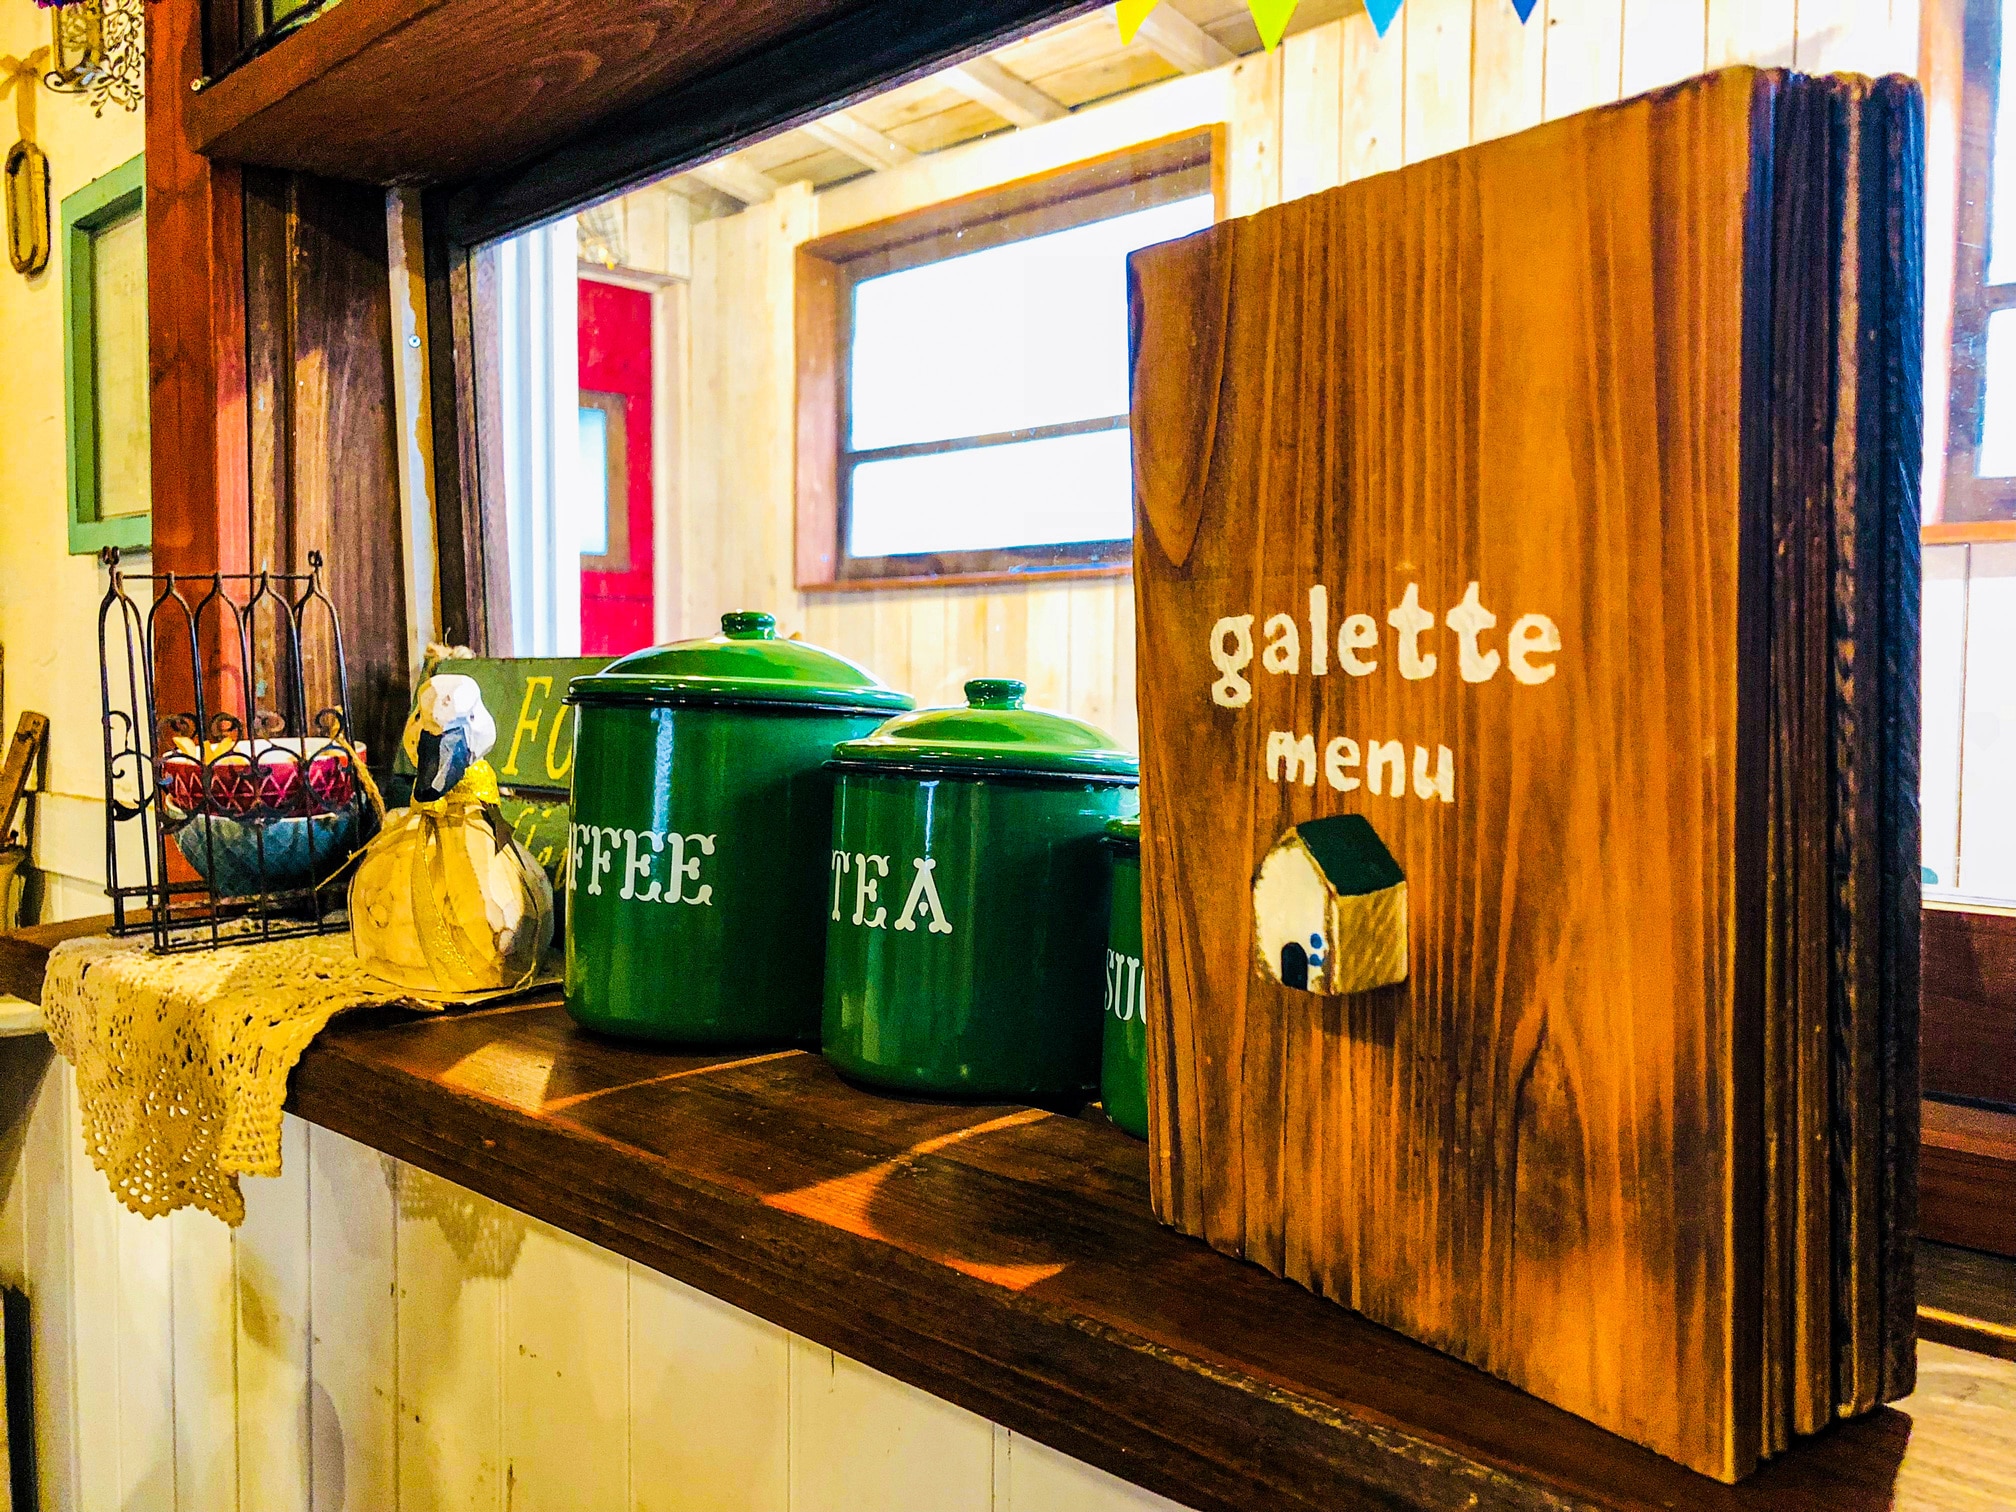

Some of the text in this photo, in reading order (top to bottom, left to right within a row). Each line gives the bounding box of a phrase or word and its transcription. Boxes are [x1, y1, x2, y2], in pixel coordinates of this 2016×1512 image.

[1208, 581, 1562, 708] galette
[1266, 730, 1455, 803] menu
[832, 849, 953, 934] TEA
[1104, 948, 1146, 1025] SU
